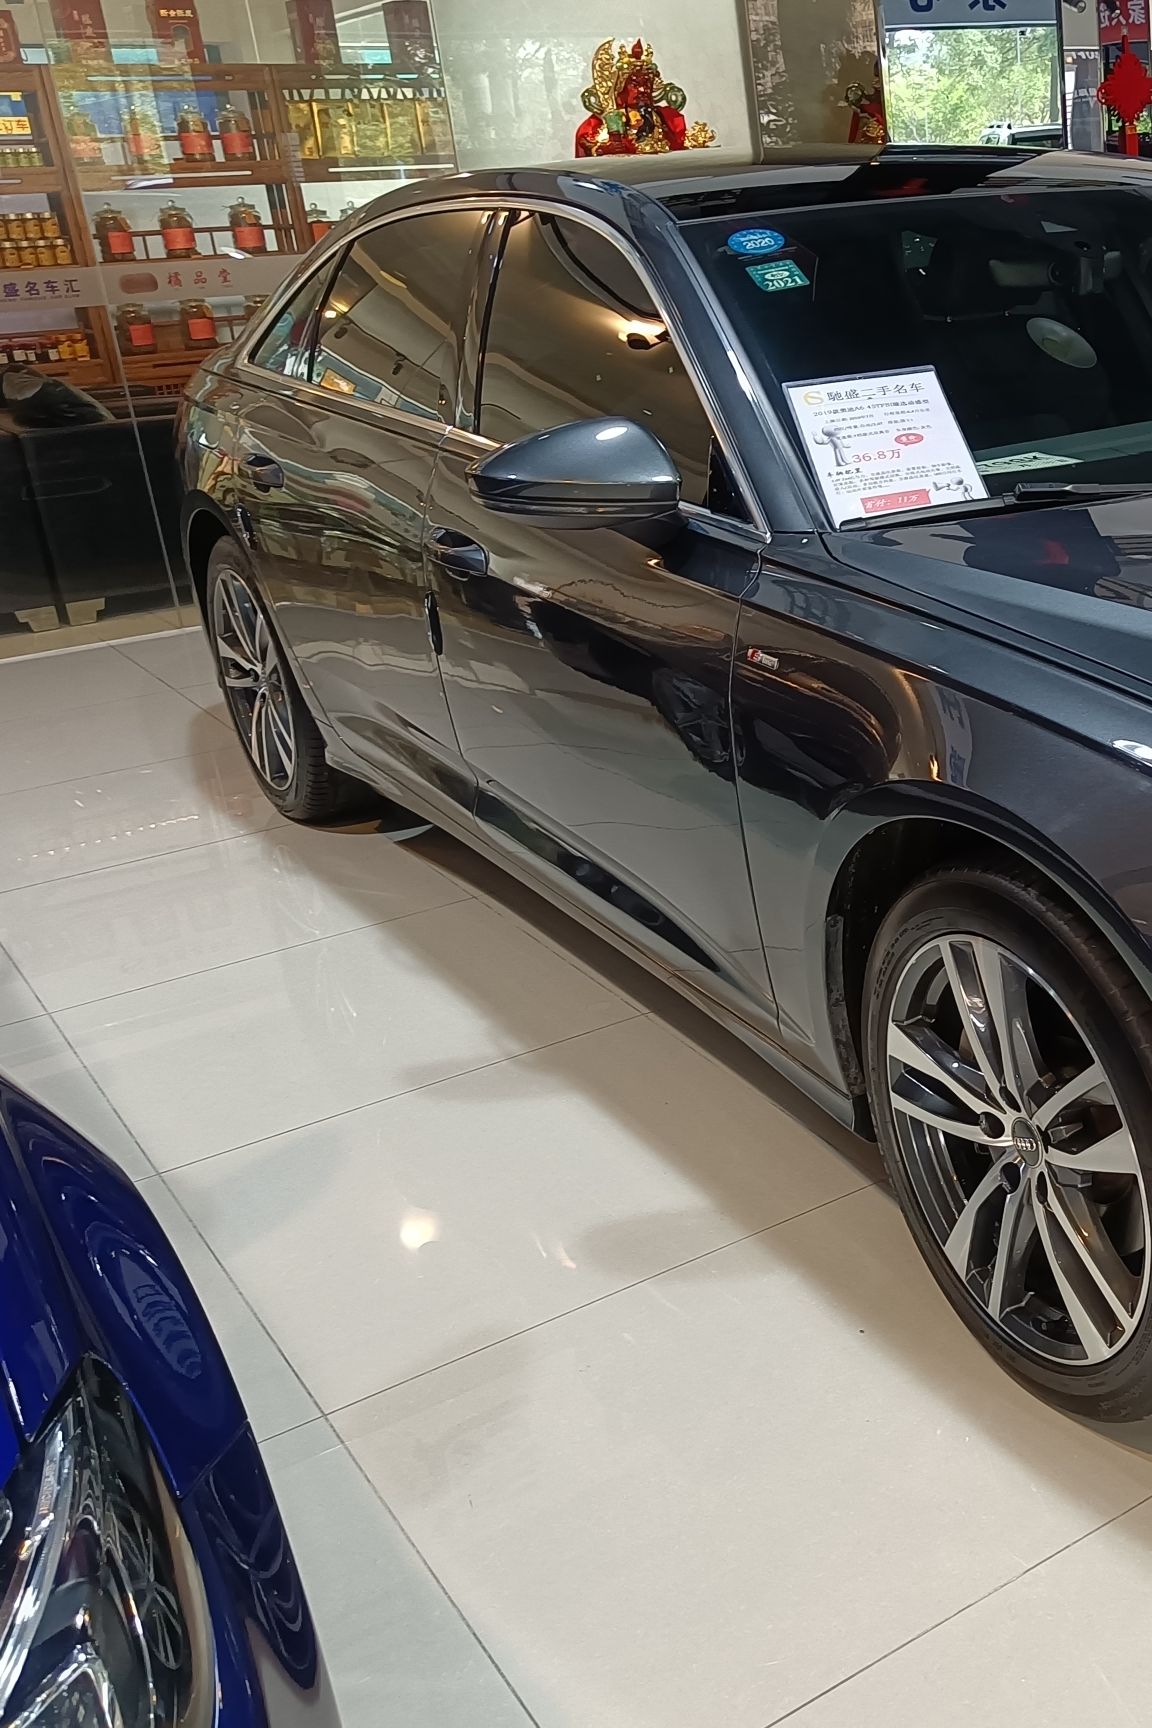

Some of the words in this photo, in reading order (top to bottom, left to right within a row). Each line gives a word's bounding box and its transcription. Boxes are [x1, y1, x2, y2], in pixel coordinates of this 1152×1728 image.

[742, 237, 775, 250] 2020
[3, 279, 81, 298] 盛名车汇
[763, 275, 805, 290] 2021
[852, 449, 901, 464] 36.8万
